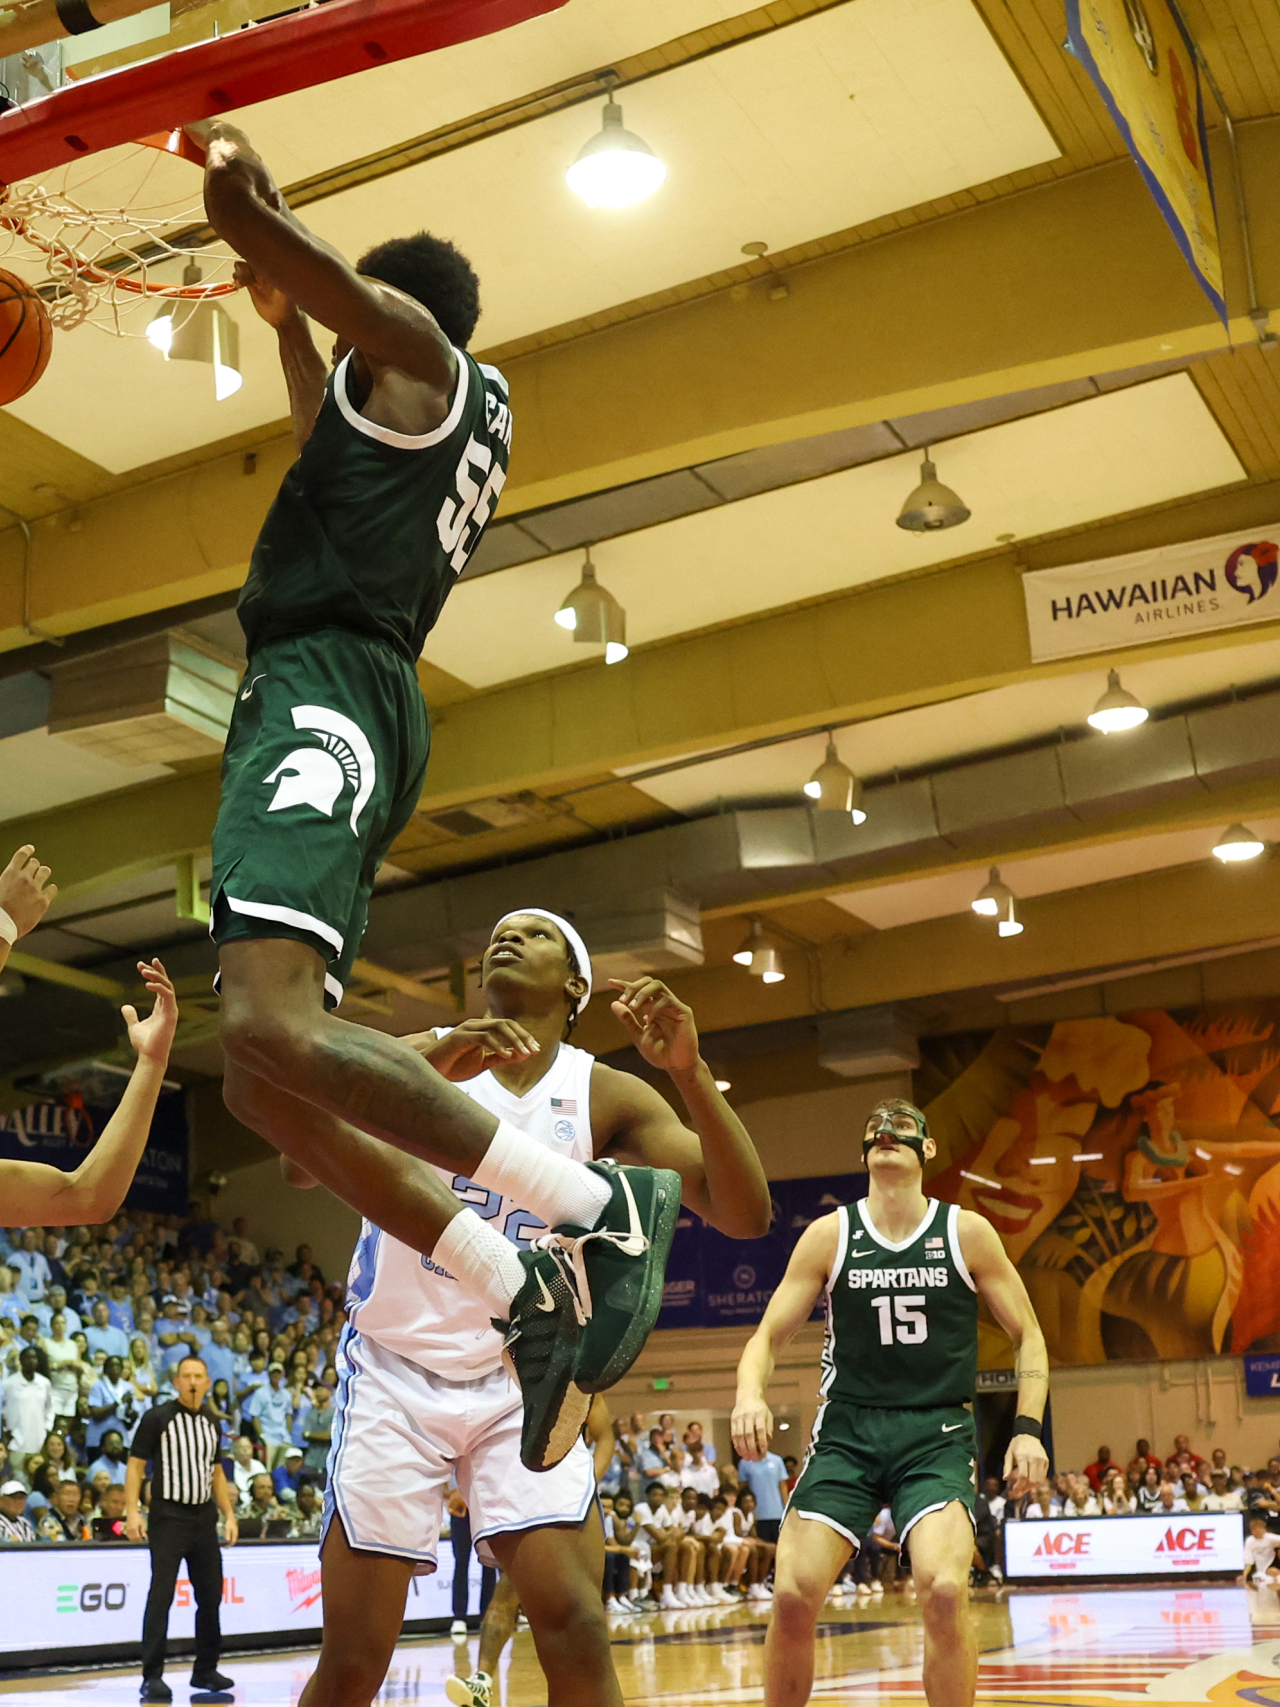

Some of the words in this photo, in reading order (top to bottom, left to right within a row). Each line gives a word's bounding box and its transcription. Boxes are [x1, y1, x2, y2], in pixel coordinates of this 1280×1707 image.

[1051, 569, 1217, 622] HAWAIIAN
[1134, 598, 1220, 624] AIRLINES
[848, 1267, 948, 1289] SPARTANS
[871, 1294, 928, 1346] 15
[1034, 1531, 1092, 1556] ACE
[1155, 1525, 1216, 1552] ACE
[57, 1583, 126, 1612] EGO
